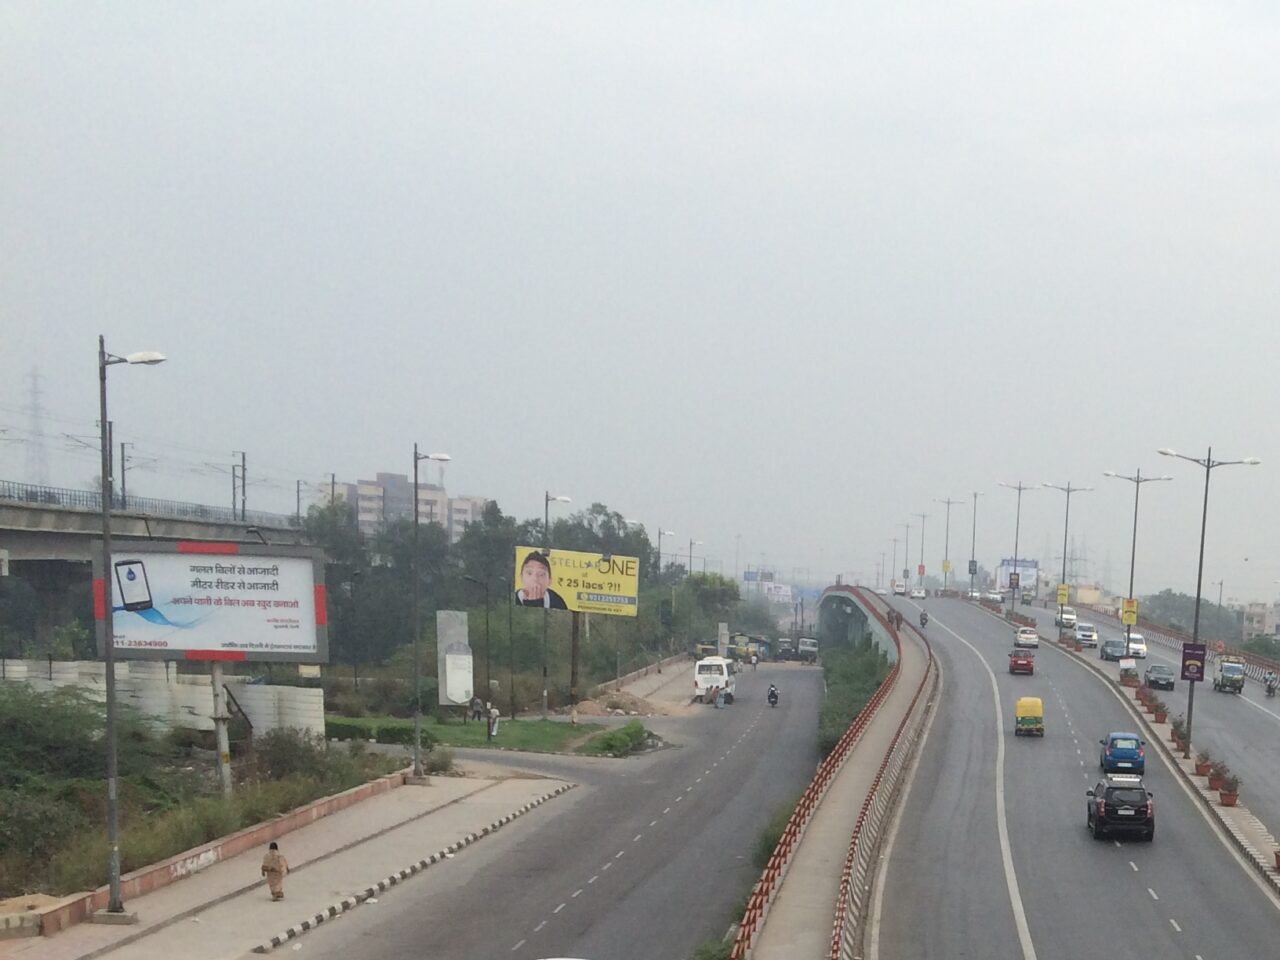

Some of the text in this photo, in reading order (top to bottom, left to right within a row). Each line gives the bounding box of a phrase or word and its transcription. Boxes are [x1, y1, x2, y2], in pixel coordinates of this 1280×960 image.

[189, 565, 214, 575] गलत
[215, 563, 236, 575] बिलों
[237, 564, 246, 576] से
[598, 558, 636, 577] ONE
[190, 577, 213, 590] मीटर
[215, 578, 236, 590] रीडर
[237, 579, 246, 591] से
[566, 579, 579, 588] 25
